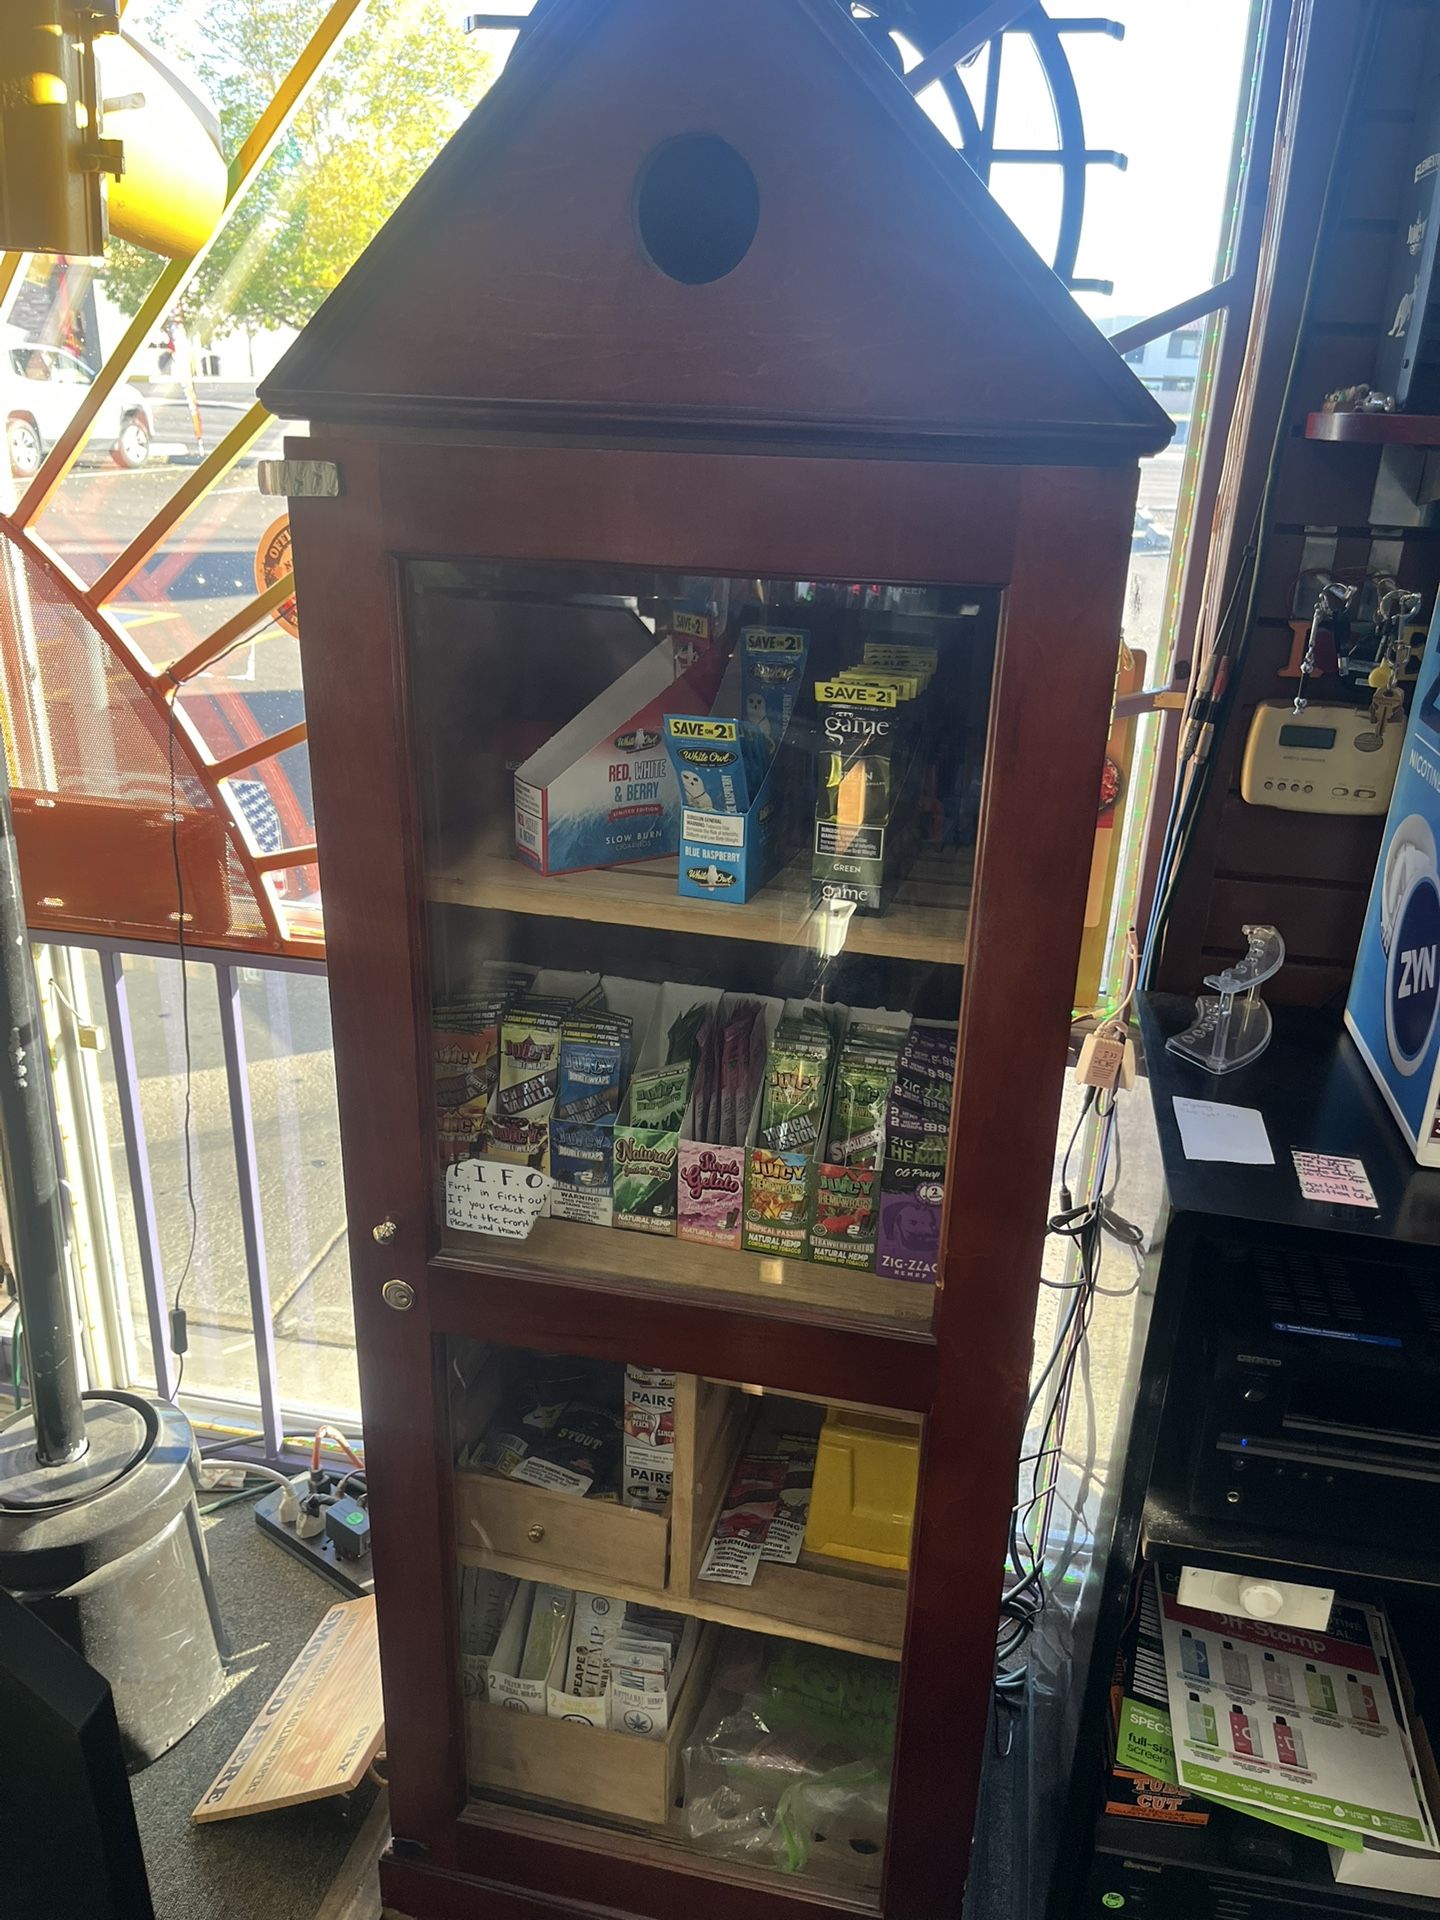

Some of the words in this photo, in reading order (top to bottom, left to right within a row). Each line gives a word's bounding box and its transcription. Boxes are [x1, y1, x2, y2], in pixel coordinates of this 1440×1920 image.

[748, 636, 776, 650] SAVE
[785, 638, 796, 650] 2
[824, 686, 867, 701] SAVE
[876, 691, 886, 703] 2
[673, 721, 703, 736] SAVE
[714, 724, 728, 739] 2
[682, 750, 708, 763] White
[709, 752, 730, 763] Owl
[608, 764, 631, 782] RED,
[634, 759, 666, 778] WHITE
[615, 786, 622, 802] &
[626, 781, 660, 801] BERRY
[606, 833, 632, 845] SLOW
[637, 830, 662, 840] BURN
[685, 846, 700, 858] BLUE
[702, 849, 740, 862] RASPBERRY
[833, 863, 861, 873] GREEN
[1398, 944, 1437, 999] ZYN
[505, 1035, 555, 1061] JUICY
[564, 1049, 617, 1076] JUICY
[763, 1114, 813, 1141] TROPICAL
[615, 1137, 677, 1166] Natural
[699, 1151, 740, 1177] Purple
[752, 1156, 806, 1181] JUICY
[895, 1168, 911, 1178] OG
[681, 1164, 740, 1200] Gelato
[820, 1171, 873, 1195] JUICY
[528, 1194, 547, 1204] out
[561, 1191, 602, 1203] WARNING!
[931, 1187, 938, 1196] 2
[469, 1201, 485, 1212] you
[448, 1208, 462, 1218] old
[469, 1211, 478, 1220] to
[481, 1214, 499, 1223] the
[618, 1213, 649, 1225] NATURAL
[650, 1218, 671, 1227] HEMP
[781, 1210, 793, 1220] 2
[478, 1224, 493, 1232] and
[682, 1227, 713, 1238] NATURAL
[715, 1232, 735, 1241] HEMP
[847, 1225, 860, 1235] 2
[748, 1233, 780, 1244] NATURAL
[781, 1239, 801, 1248] HEMP
[814, 1248, 846, 1258] NATURAL
[848, 1252, 868, 1261] HEMP
[632, 1391, 675, 1408] PAIRS
[632, 1413, 649, 1421] WHITE
[632, 1419, 649, 1429] PEACH
[557, 1428, 603, 1450] STOUT
[630, 1468, 672, 1484] PAIRS
[772, 1518, 803, 1531] RNING!
[714, 1538, 761, 1550] WARNING!
[265, 1609, 345, 1716] SMOKED
[585, 1626, 605, 1686] HEMP
[600, 1658, 611, 1688] WRAPS
[489, 1675, 497, 1689] 2
[521, 1690, 542, 1700] WRAPS
[1130, 1713, 1172, 1736] SPECS
[1127, 1744, 1168, 1764] screen
[204, 1722, 272, 1805] HERE
[1137, 1795, 1182, 1811] CUT
